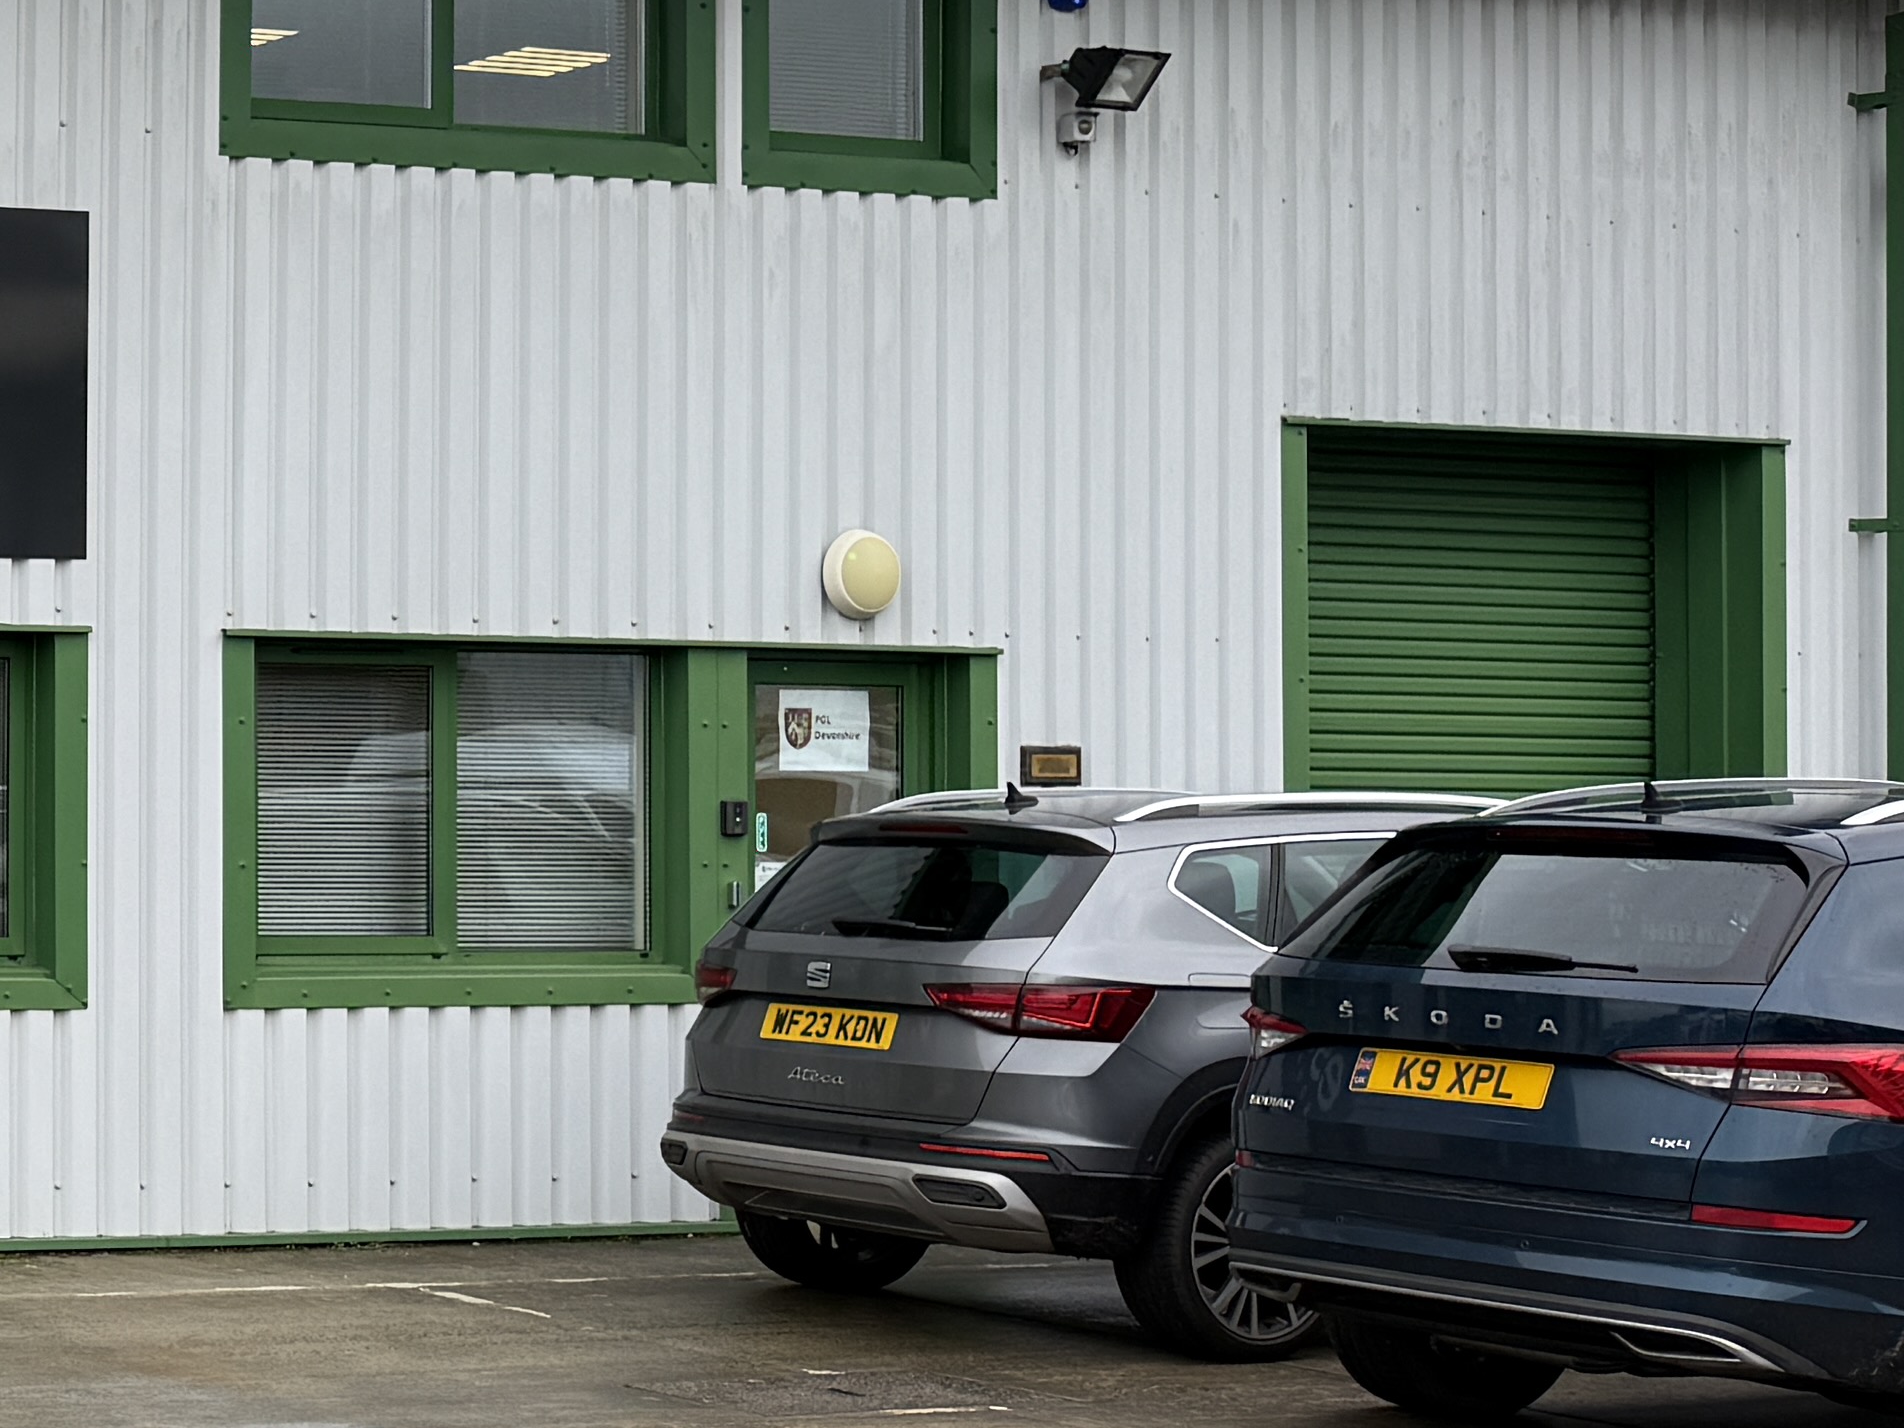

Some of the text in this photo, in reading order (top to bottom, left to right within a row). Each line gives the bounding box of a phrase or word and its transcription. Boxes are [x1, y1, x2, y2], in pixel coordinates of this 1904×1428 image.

[772, 1008, 887, 1044] WF23 KDN
[787, 1066, 845, 1085] Ateca
[1392, 1056, 1513, 1100] K9 XPL
